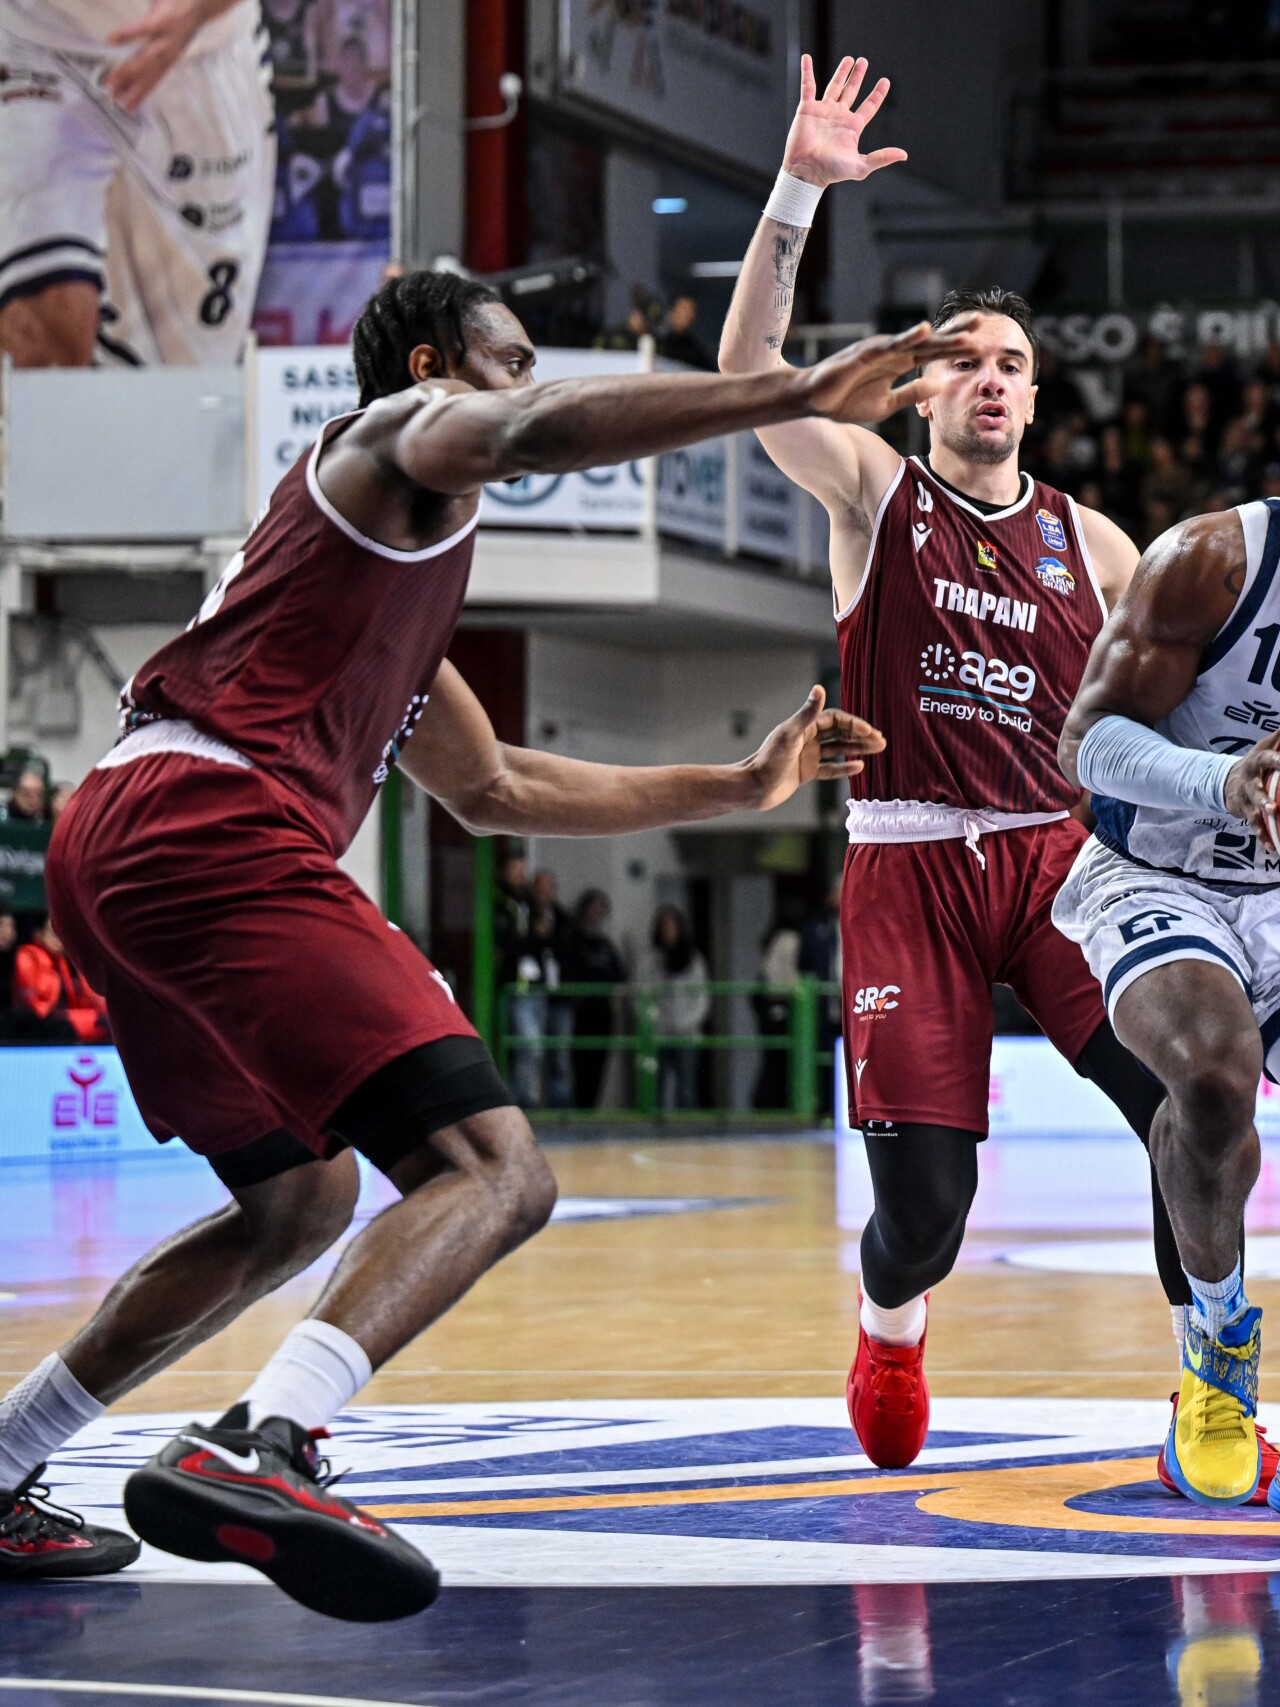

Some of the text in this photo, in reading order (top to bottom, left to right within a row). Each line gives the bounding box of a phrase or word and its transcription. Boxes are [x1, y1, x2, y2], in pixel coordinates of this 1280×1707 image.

[200, 259, 238, 326] 8
[933, 577, 1038, 633] TRAPANI
[1036, 570, 1075, 591] TRAPANI
[959, 651, 1036, 702] a29
[919, 697, 1033, 733] Energy to build
[853, 985, 901, 1014] SRC
[53, 1055, 117, 1127] EYE
